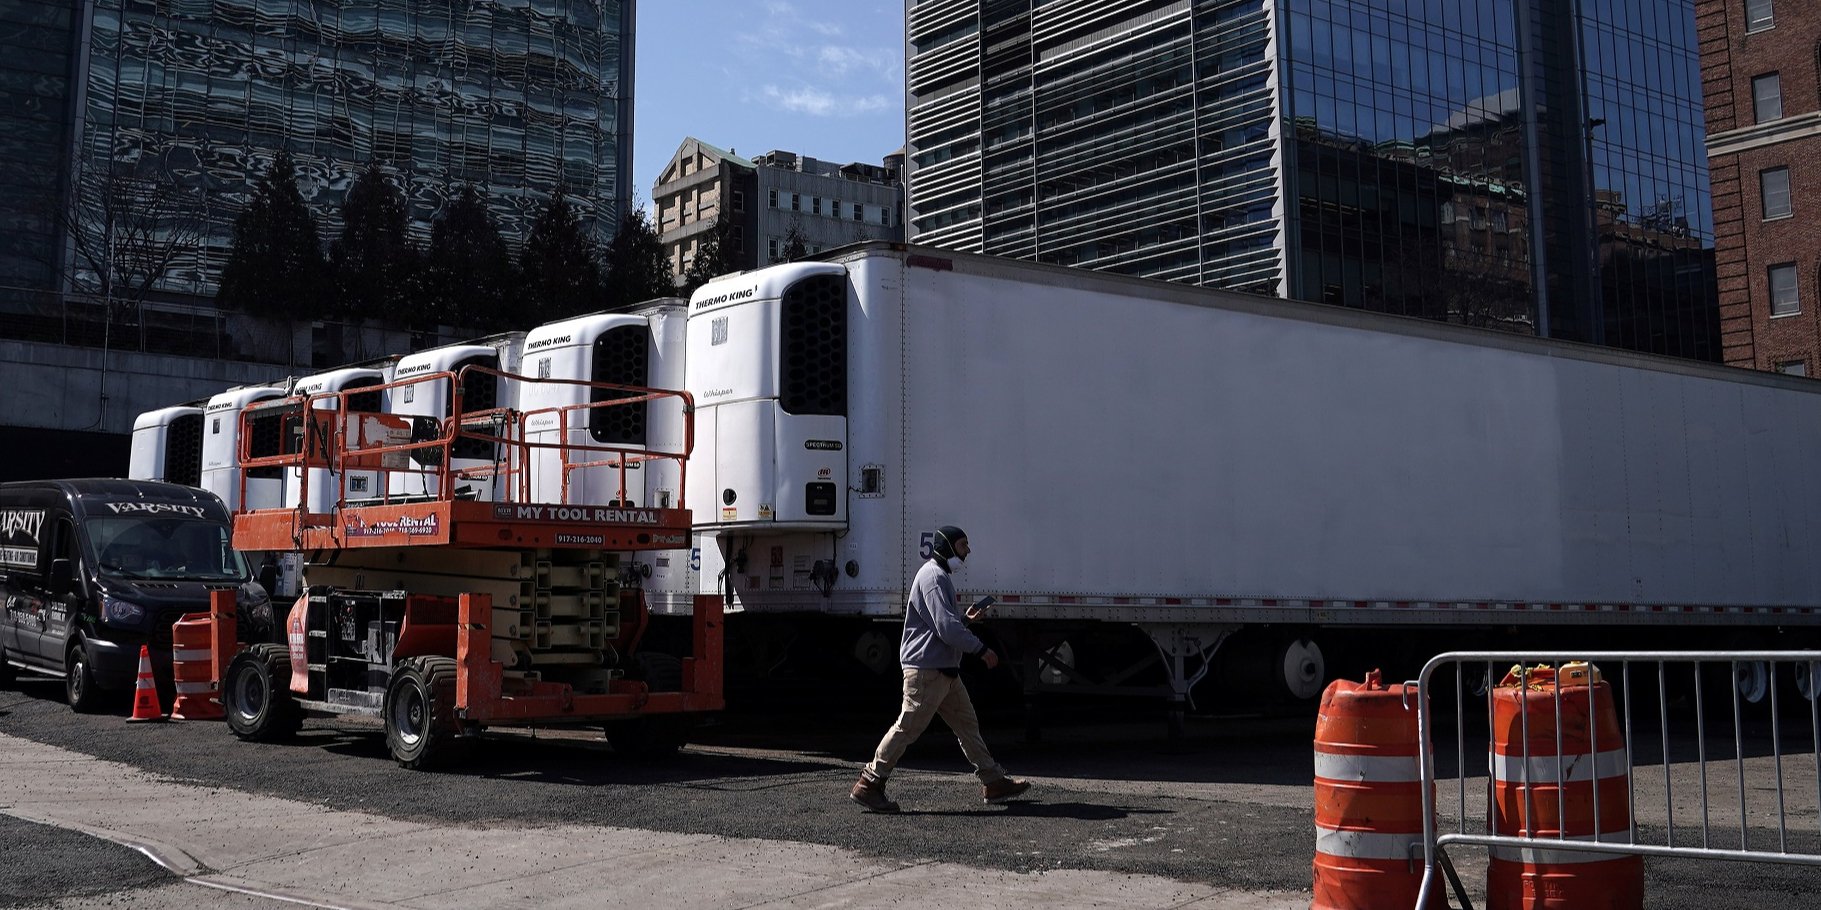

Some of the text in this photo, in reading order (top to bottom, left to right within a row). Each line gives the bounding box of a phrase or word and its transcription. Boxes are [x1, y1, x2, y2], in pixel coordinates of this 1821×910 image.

[696, 289, 753, 310] THERMO KING
[528, 335, 571, 350] THERMO KING
[417, 363, 431, 371] KING
[105, 502, 206, 519] VARSITY
[517, 506, 543, 519] MY
[547, 507, 591, 520] TOOL
[595, 509, 657, 523] RENTAL
[0, 509, 46, 545] ARSITY
[558, 535, 602, 544] 917-216-2040
[919, 532, 934, 560] 5
[690, 548, 700, 571] 5
